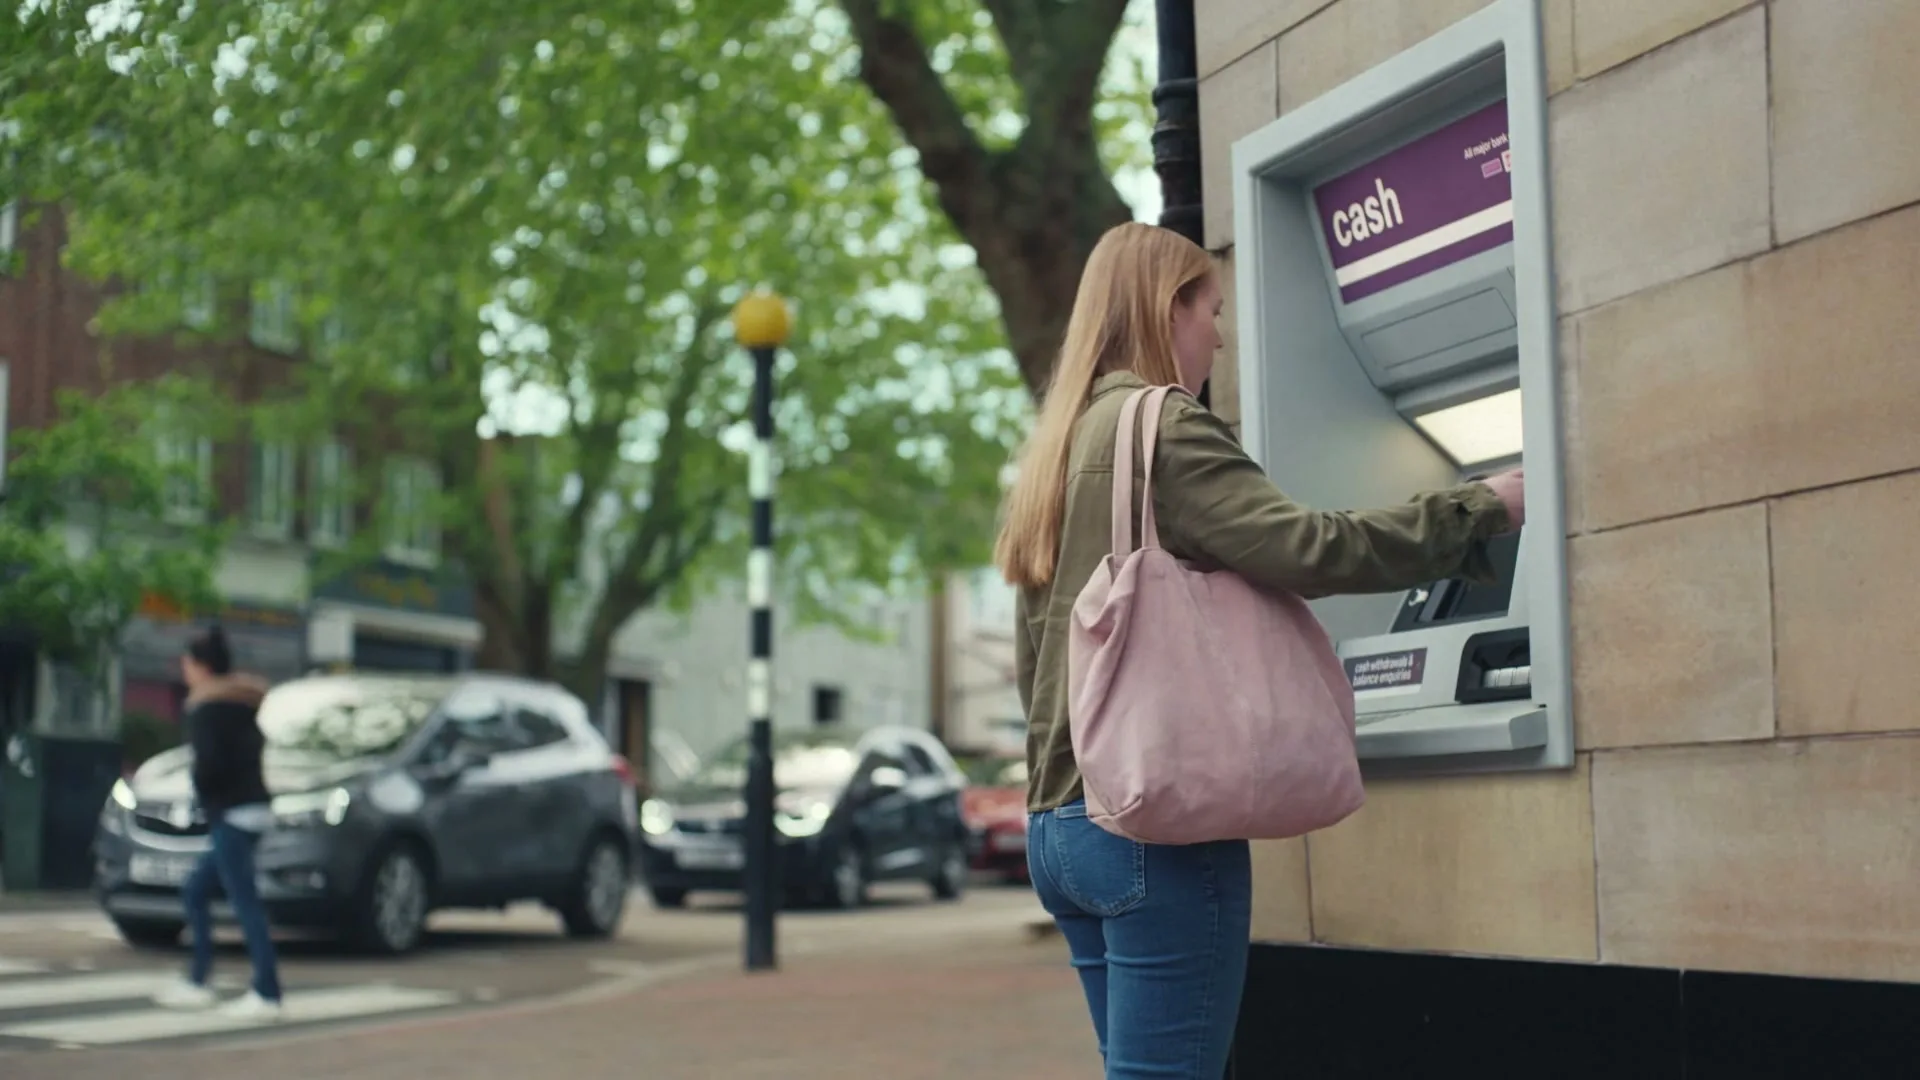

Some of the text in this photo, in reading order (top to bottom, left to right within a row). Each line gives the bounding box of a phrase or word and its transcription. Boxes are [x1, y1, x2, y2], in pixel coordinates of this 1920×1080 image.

[1463, 132, 1508, 160] All major bank
[1332, 177, 1403, 248] cash
[1355, 660, 1369, 674] cash
[1370, 656, 1408, 671] withdrawals
[1353, 672, 1378, 687] balance
